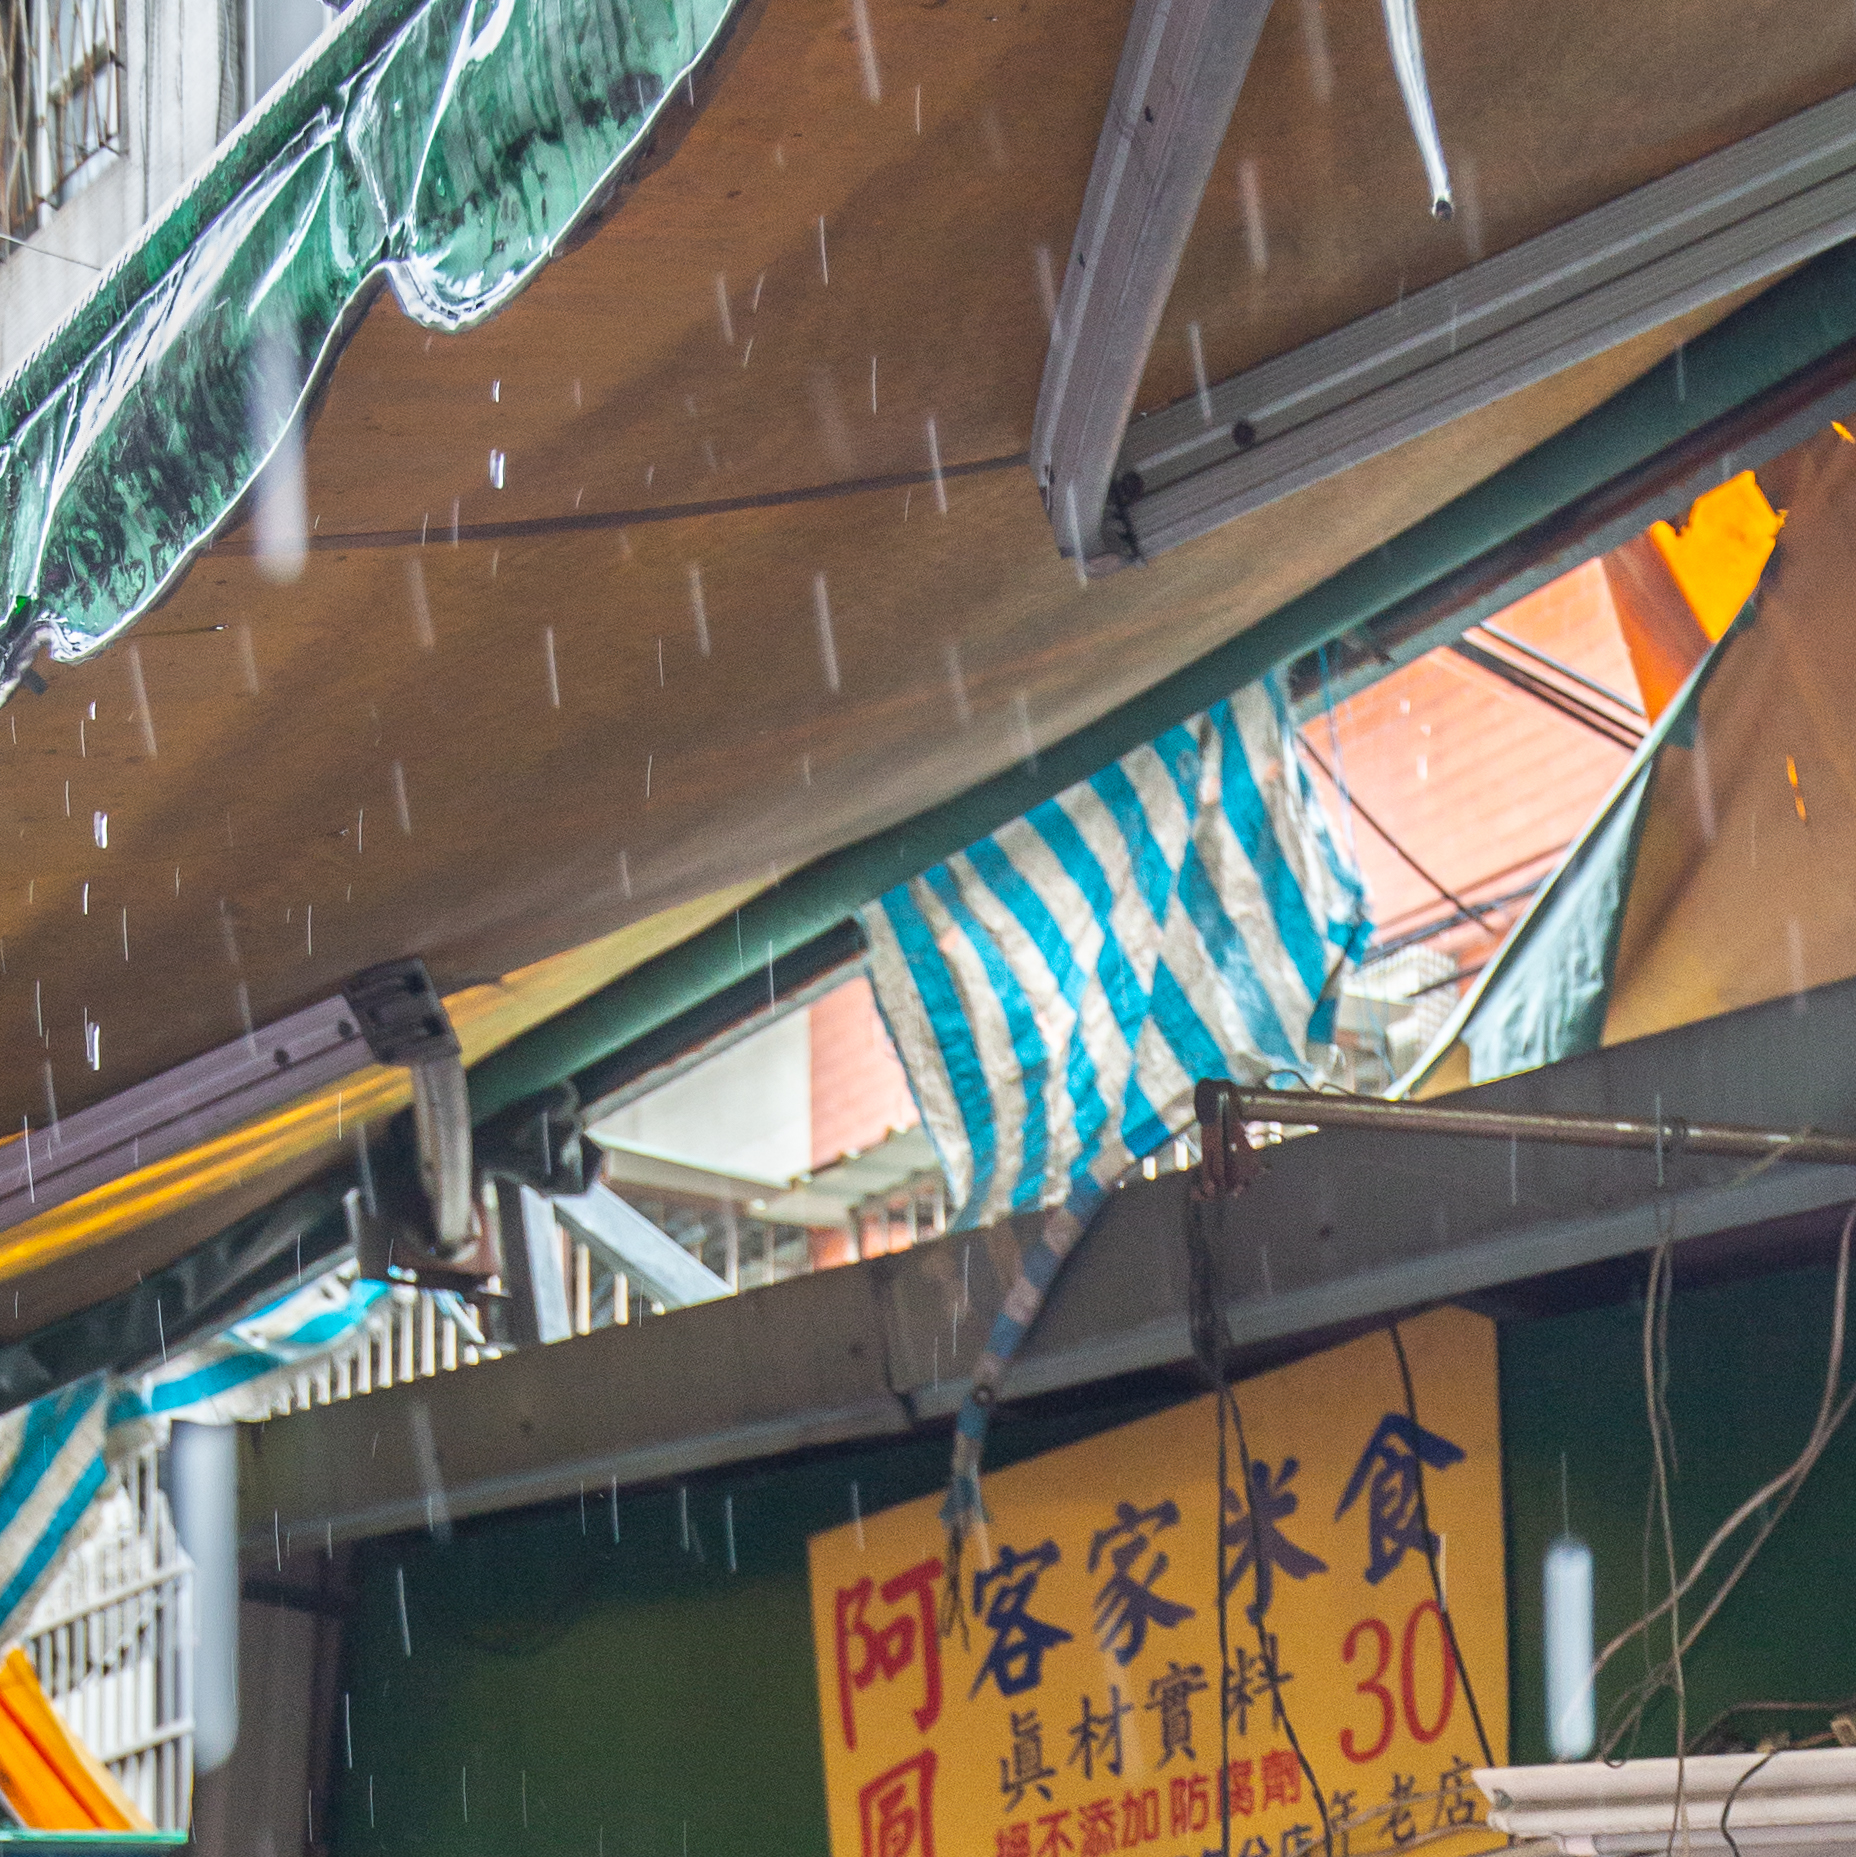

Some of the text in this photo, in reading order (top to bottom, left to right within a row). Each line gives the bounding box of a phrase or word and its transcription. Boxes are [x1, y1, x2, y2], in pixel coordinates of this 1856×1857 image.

[968, 1411, 1467, 1699] 客家米食
[1339, 1599, 1457, 1764] 30
